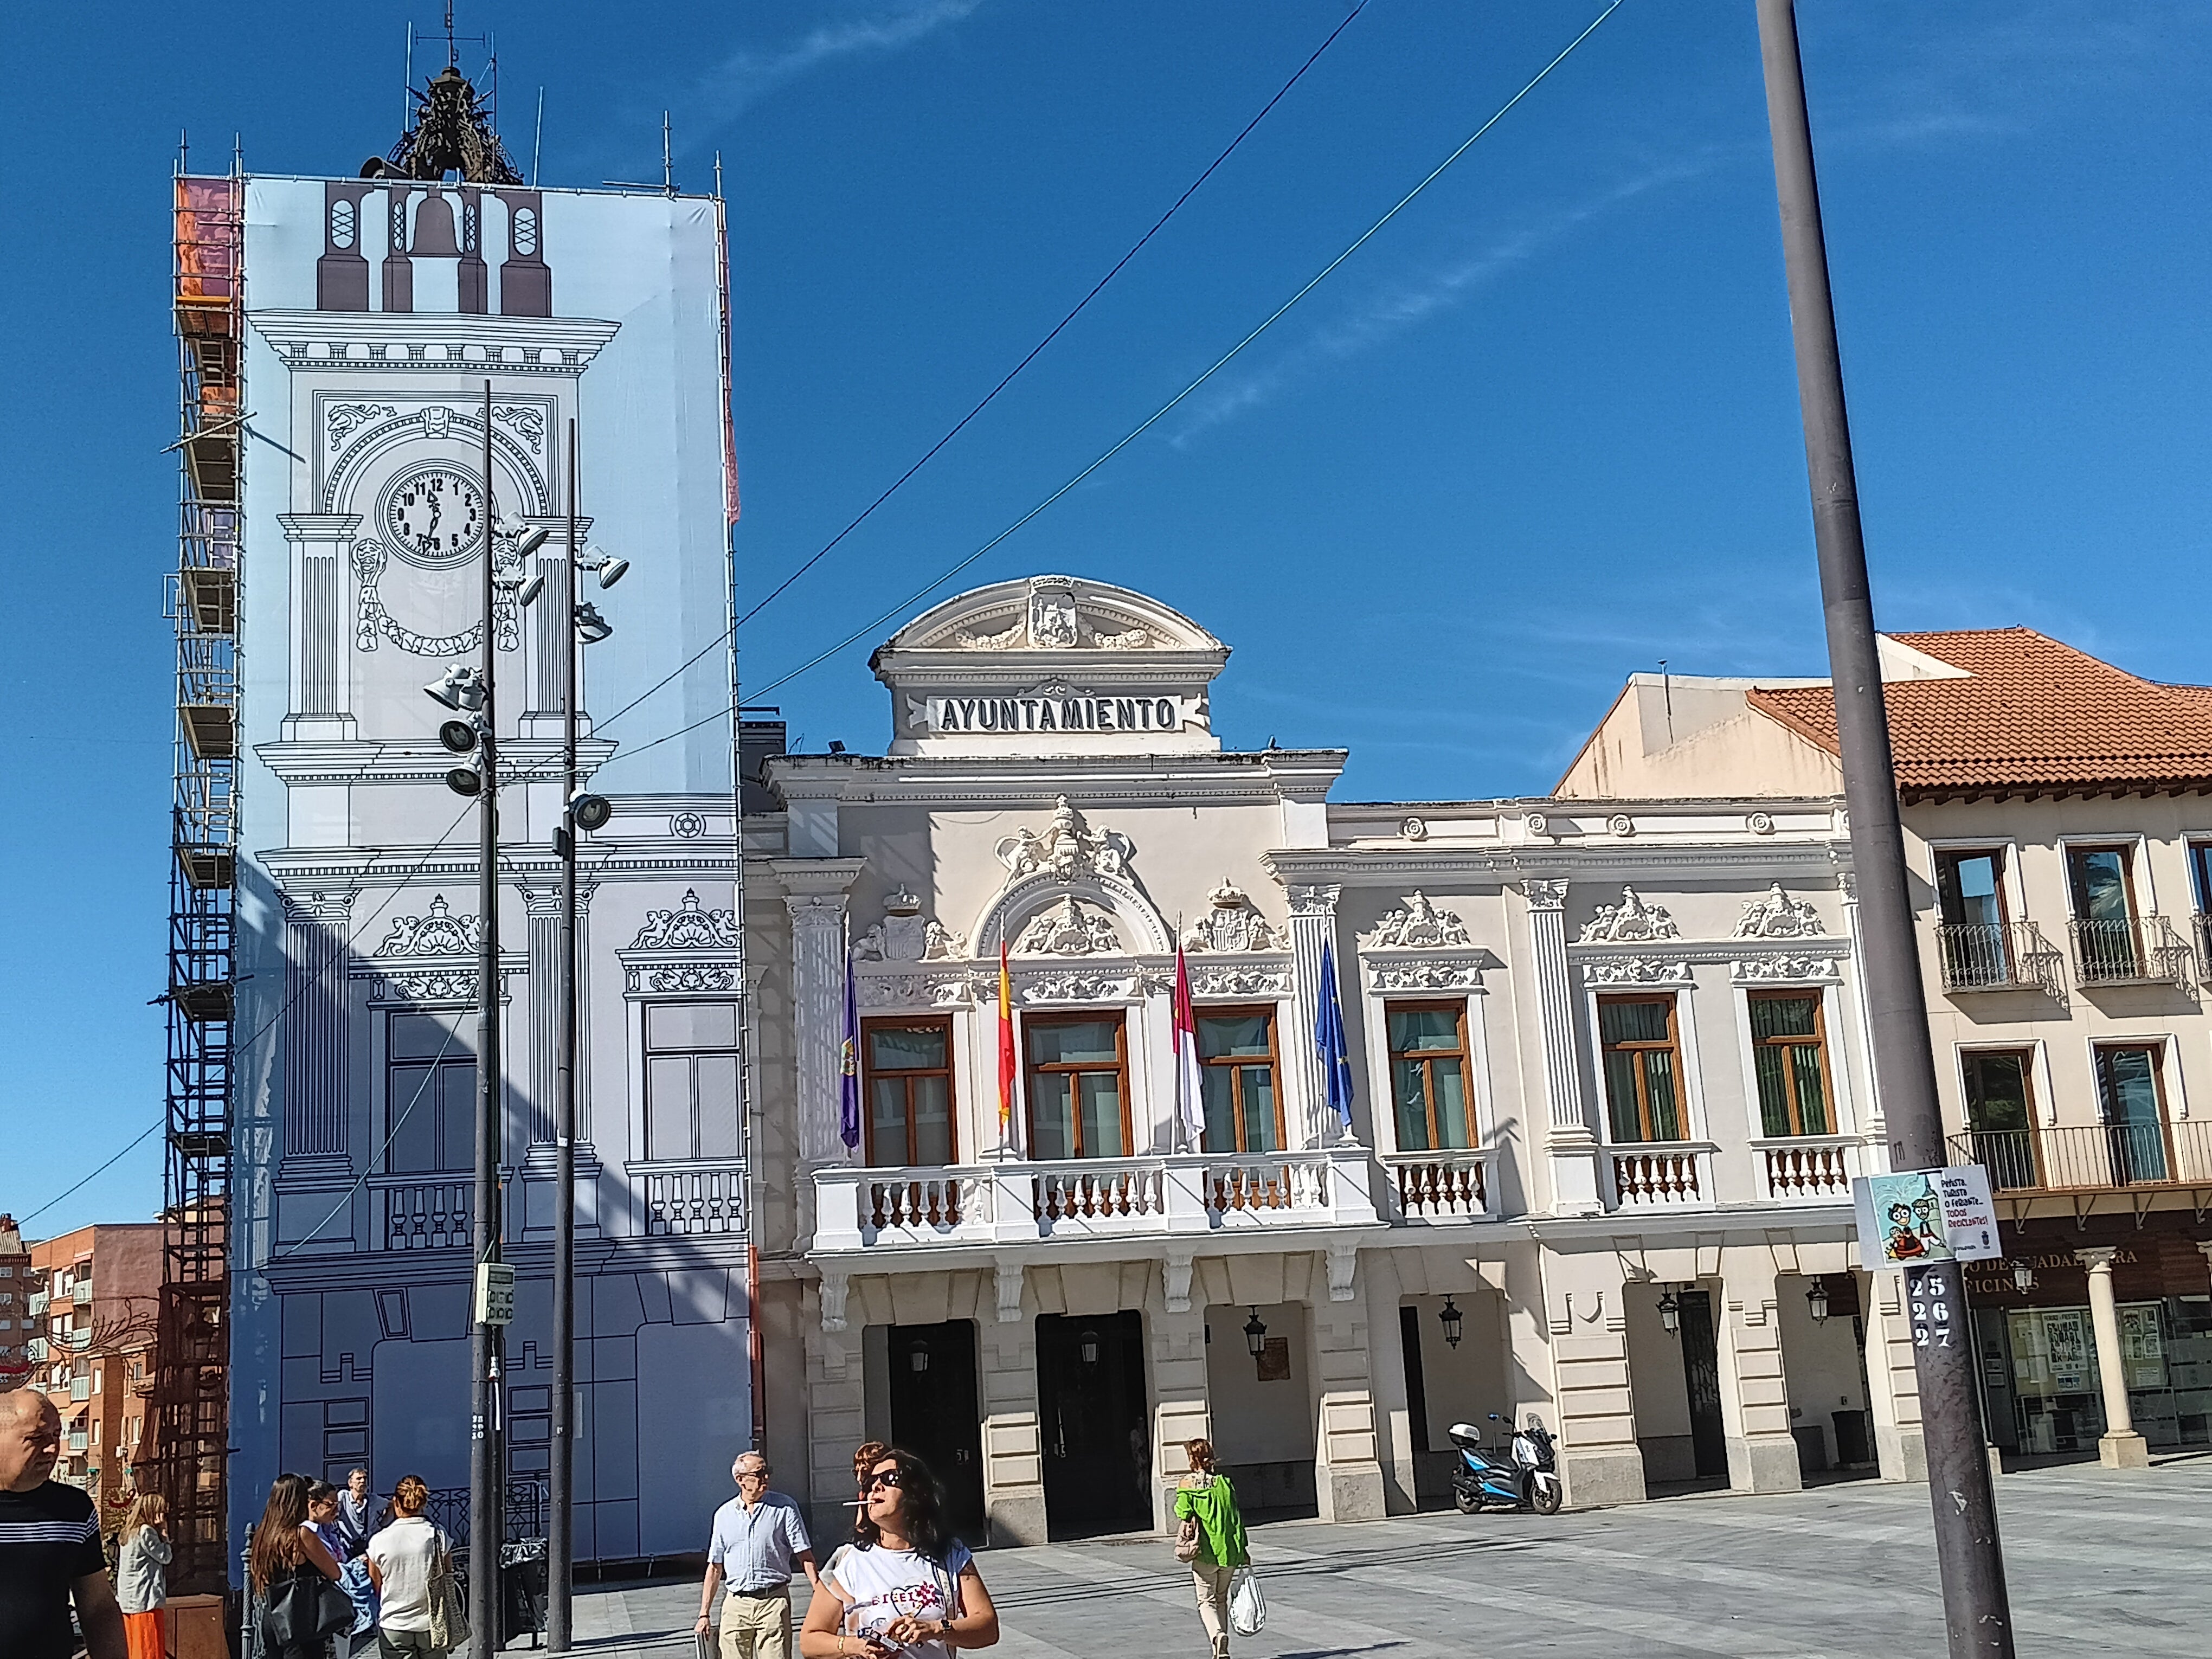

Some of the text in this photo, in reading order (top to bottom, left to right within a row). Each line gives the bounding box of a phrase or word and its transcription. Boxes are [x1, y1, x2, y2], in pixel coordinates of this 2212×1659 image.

[414, 482, 426, 496] 11
[430, 478, 443, 491] 12
[453, 482, 458, 496] 1
[402, 493, 415, 506] 10
[465, 493, 472, 506] 2
[470, 508, 476, 521] 3
[403, 522, 410, 536] 8
[464, 523, 471, 536] 4
[416, 533, 423, 547] 7
[452, 533, 458, 547] 5
[940, 698, 1175, 731] AYUNTAMIENTO
[1946, 1208, 1967, 1218] TODOS
[1909, 1277, 1945, 1296] 25
[1913, 1301, 1949, 1321] 26
[1915, 1328, 1951, 1348] 27
